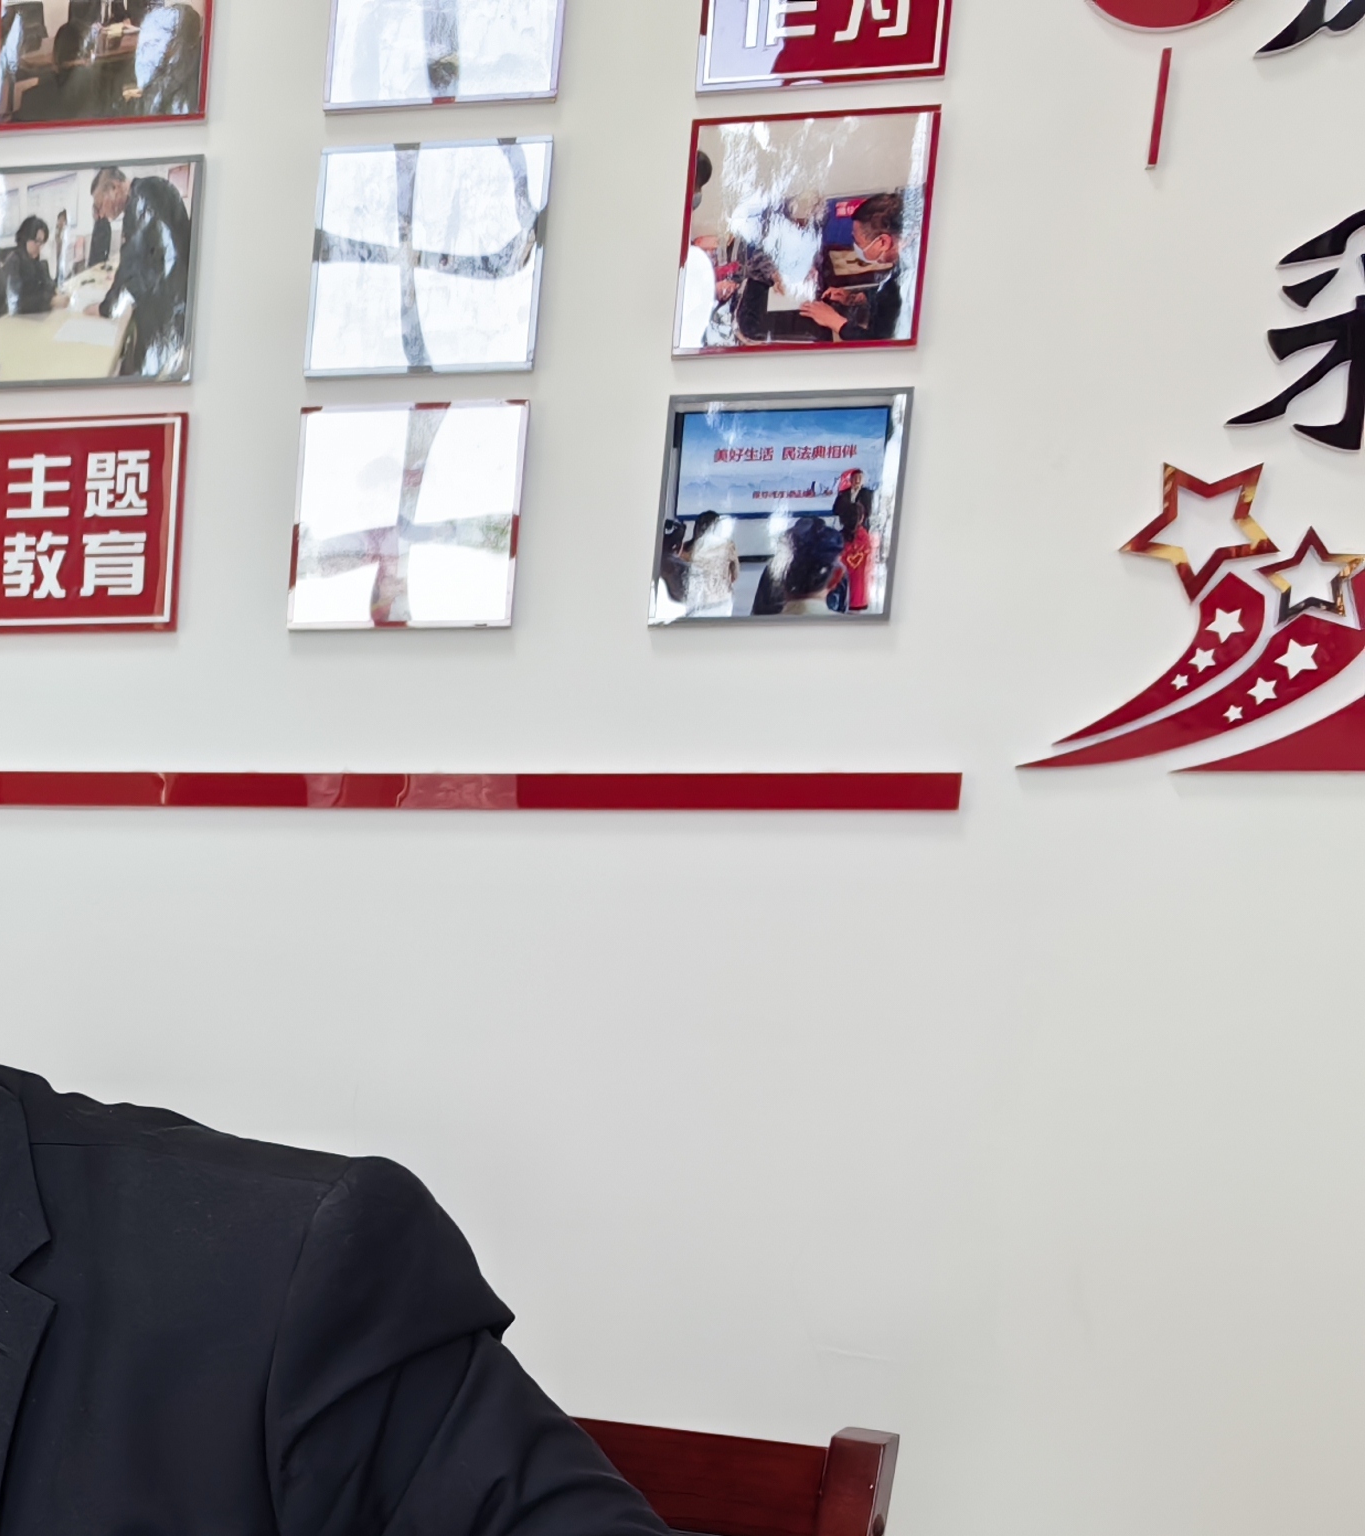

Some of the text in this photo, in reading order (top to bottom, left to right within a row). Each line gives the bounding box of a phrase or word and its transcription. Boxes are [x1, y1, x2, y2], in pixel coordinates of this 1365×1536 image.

[6, 449, 151, 519] 主题
[782, 444, 858, 461] 民法典相伴
[2, 530, 147, 599] 教育
